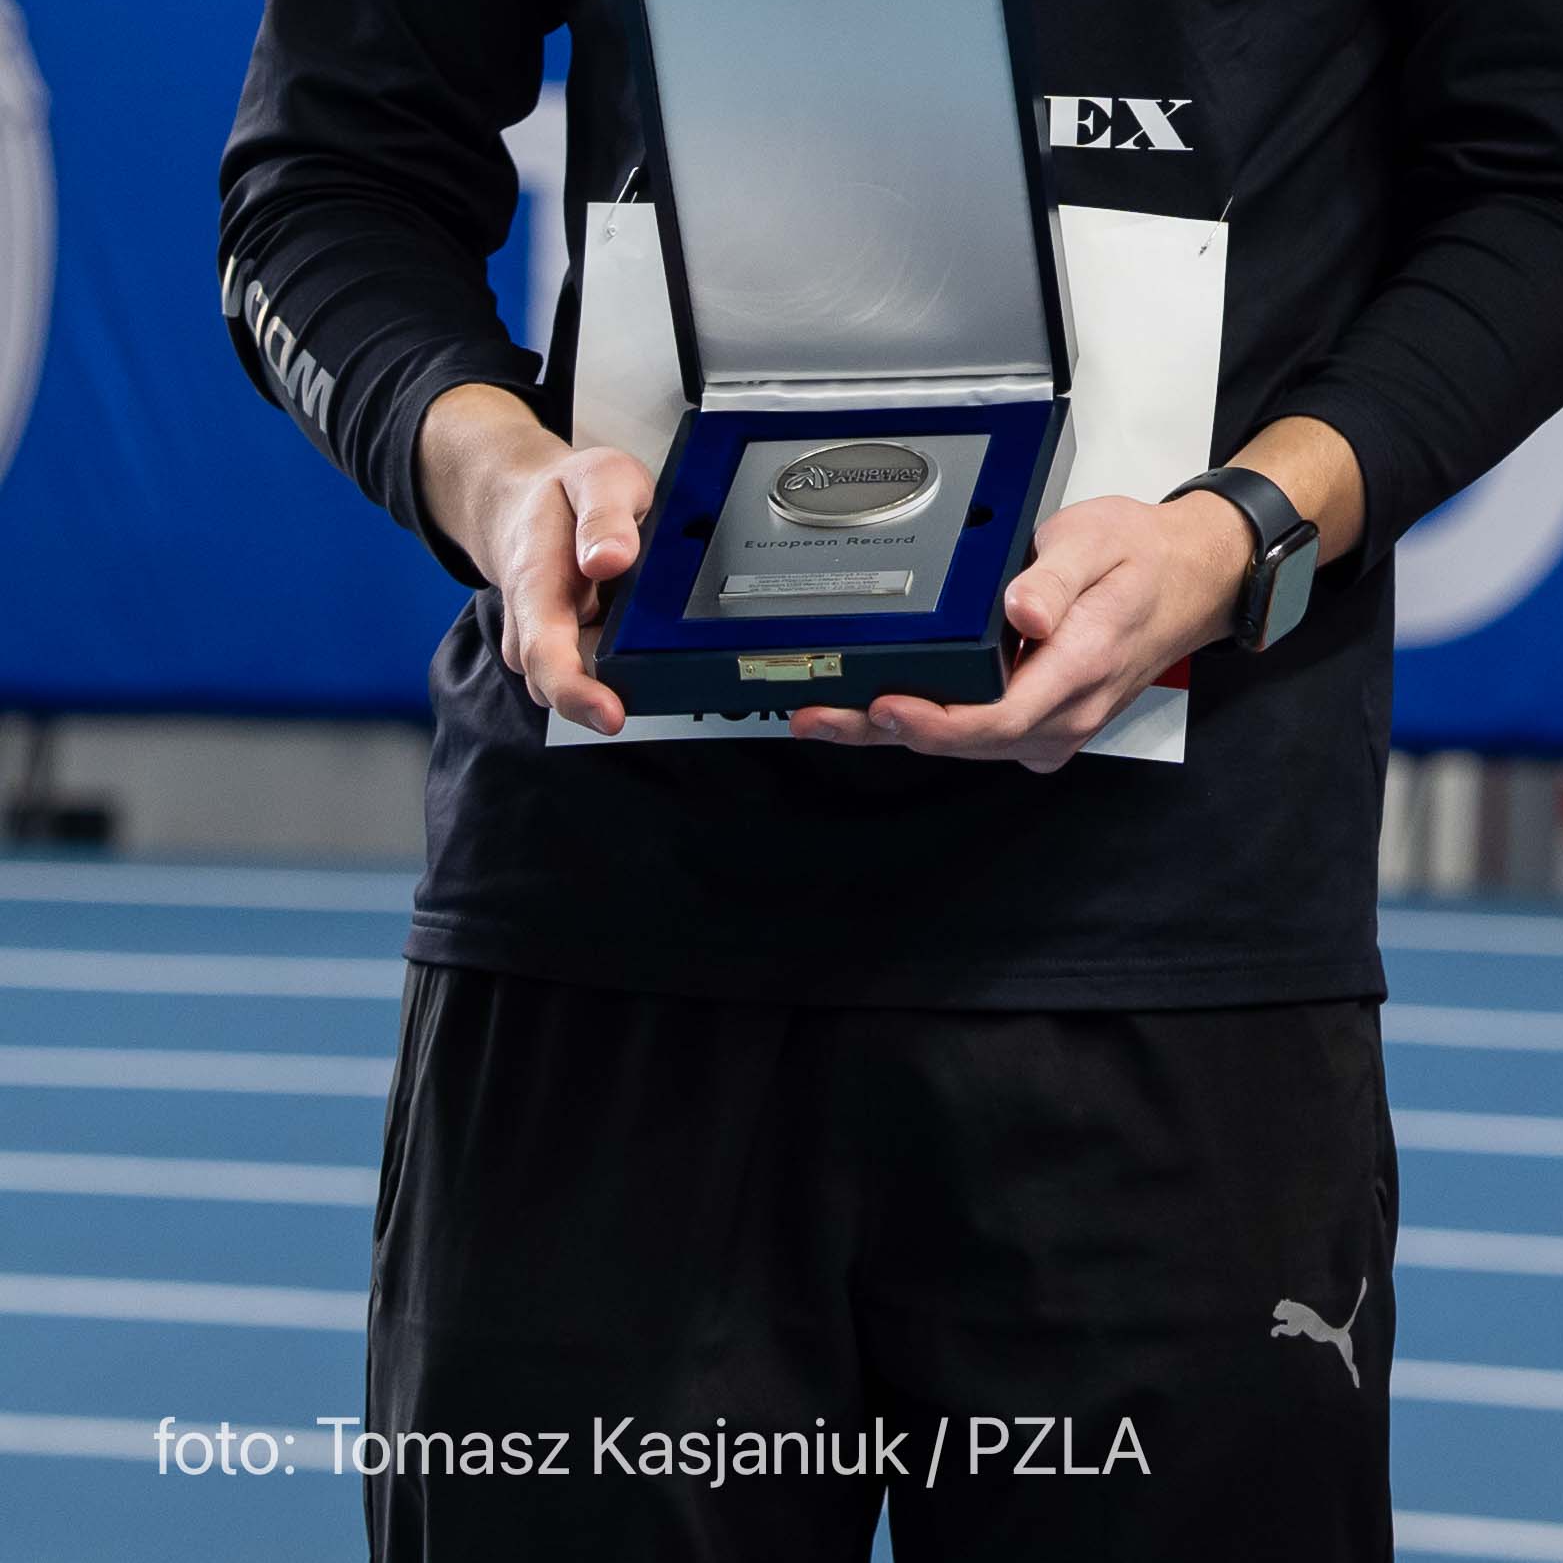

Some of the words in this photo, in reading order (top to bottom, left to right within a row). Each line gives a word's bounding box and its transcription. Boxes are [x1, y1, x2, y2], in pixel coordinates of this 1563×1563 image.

[1044, 95, 1194, 150] EX
[744, 539, 839, 550] European
[846, 535, 916, 546] Record
